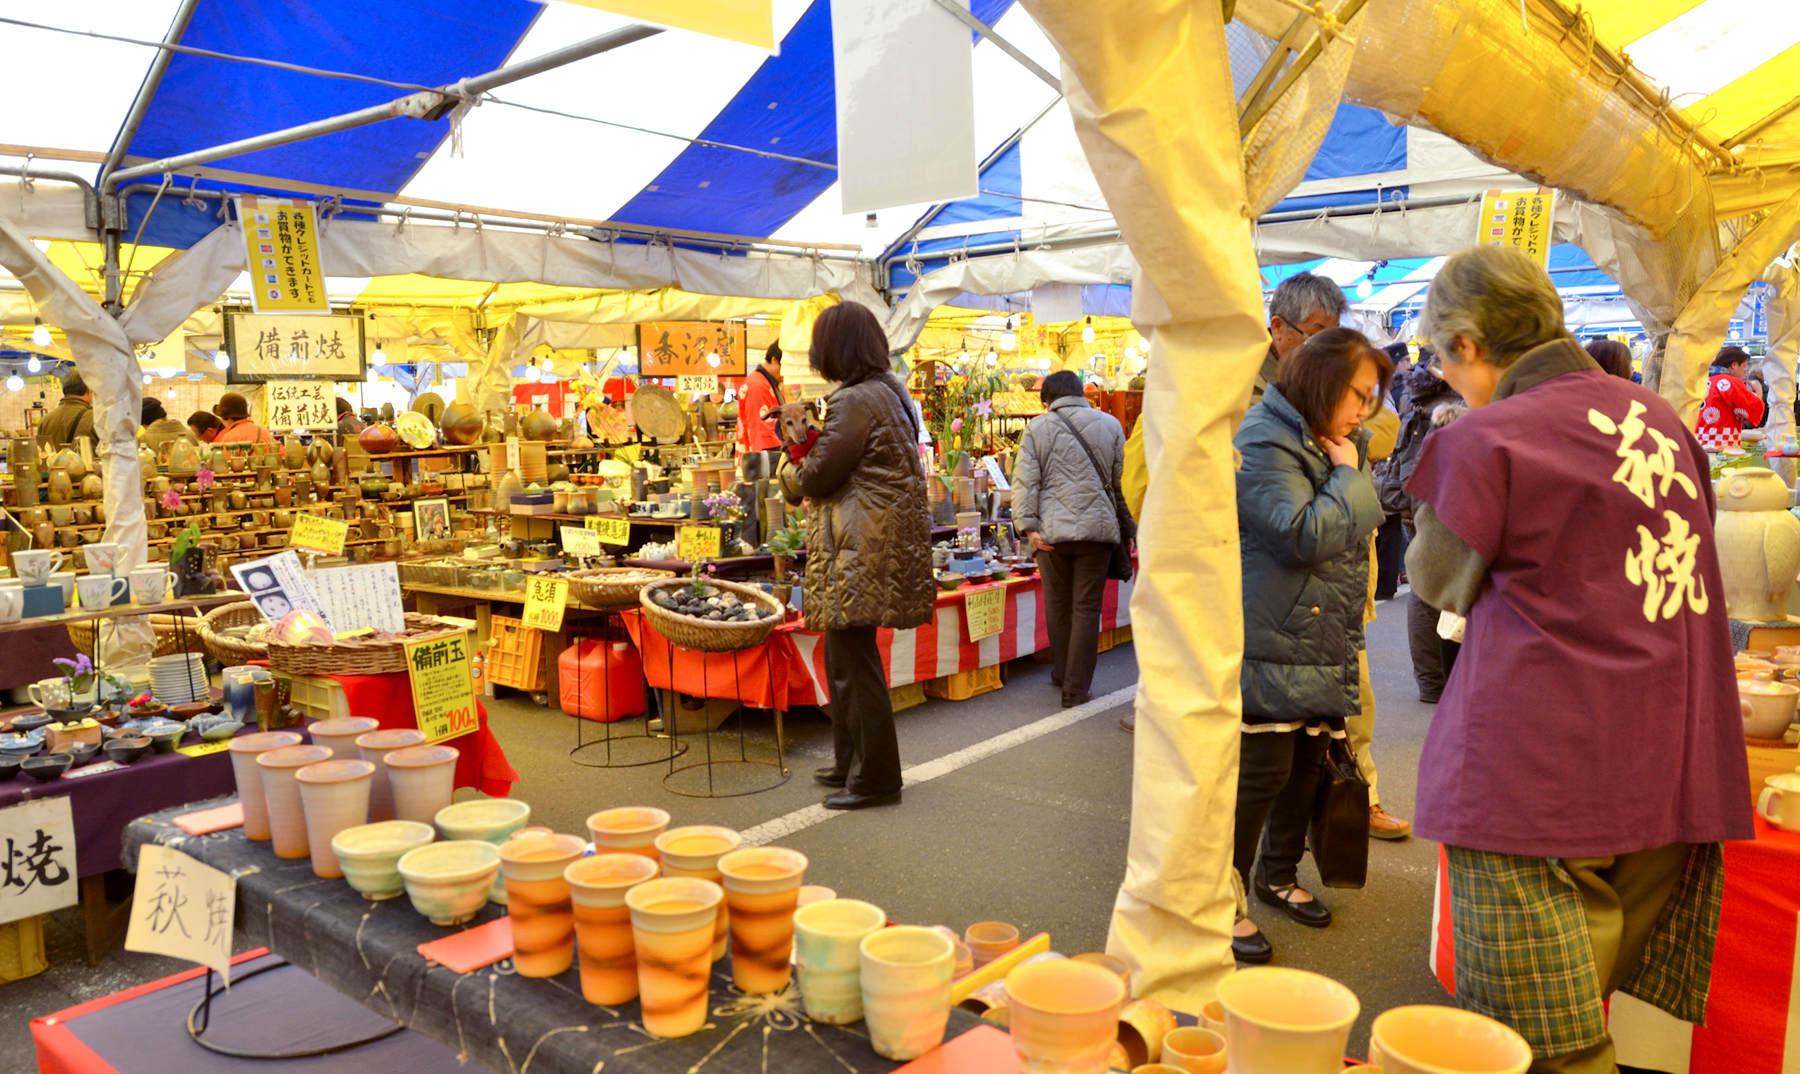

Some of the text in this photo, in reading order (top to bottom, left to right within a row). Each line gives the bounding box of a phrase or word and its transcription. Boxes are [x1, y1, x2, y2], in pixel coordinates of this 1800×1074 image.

[1527, 197, 1543, 256] 各種クレジットカ
[277, 211, 301, 302] お買物ができます。
[293, 212, 316, 303] 各種クレジットカードでも
[254, 327, 346, 361] 備前焼
[271, 385, 325, 401] 伝統工芸
[682, 376, 715, 391] 笠間焼
[271, 402, 334, 426] 備前焼
[532, 581, 556, 603] 急須
[412, 639, 465, 671] 備前玉
[1, 829, 69, 896] 焼
[146, 865, 230, 961] 萩焼
